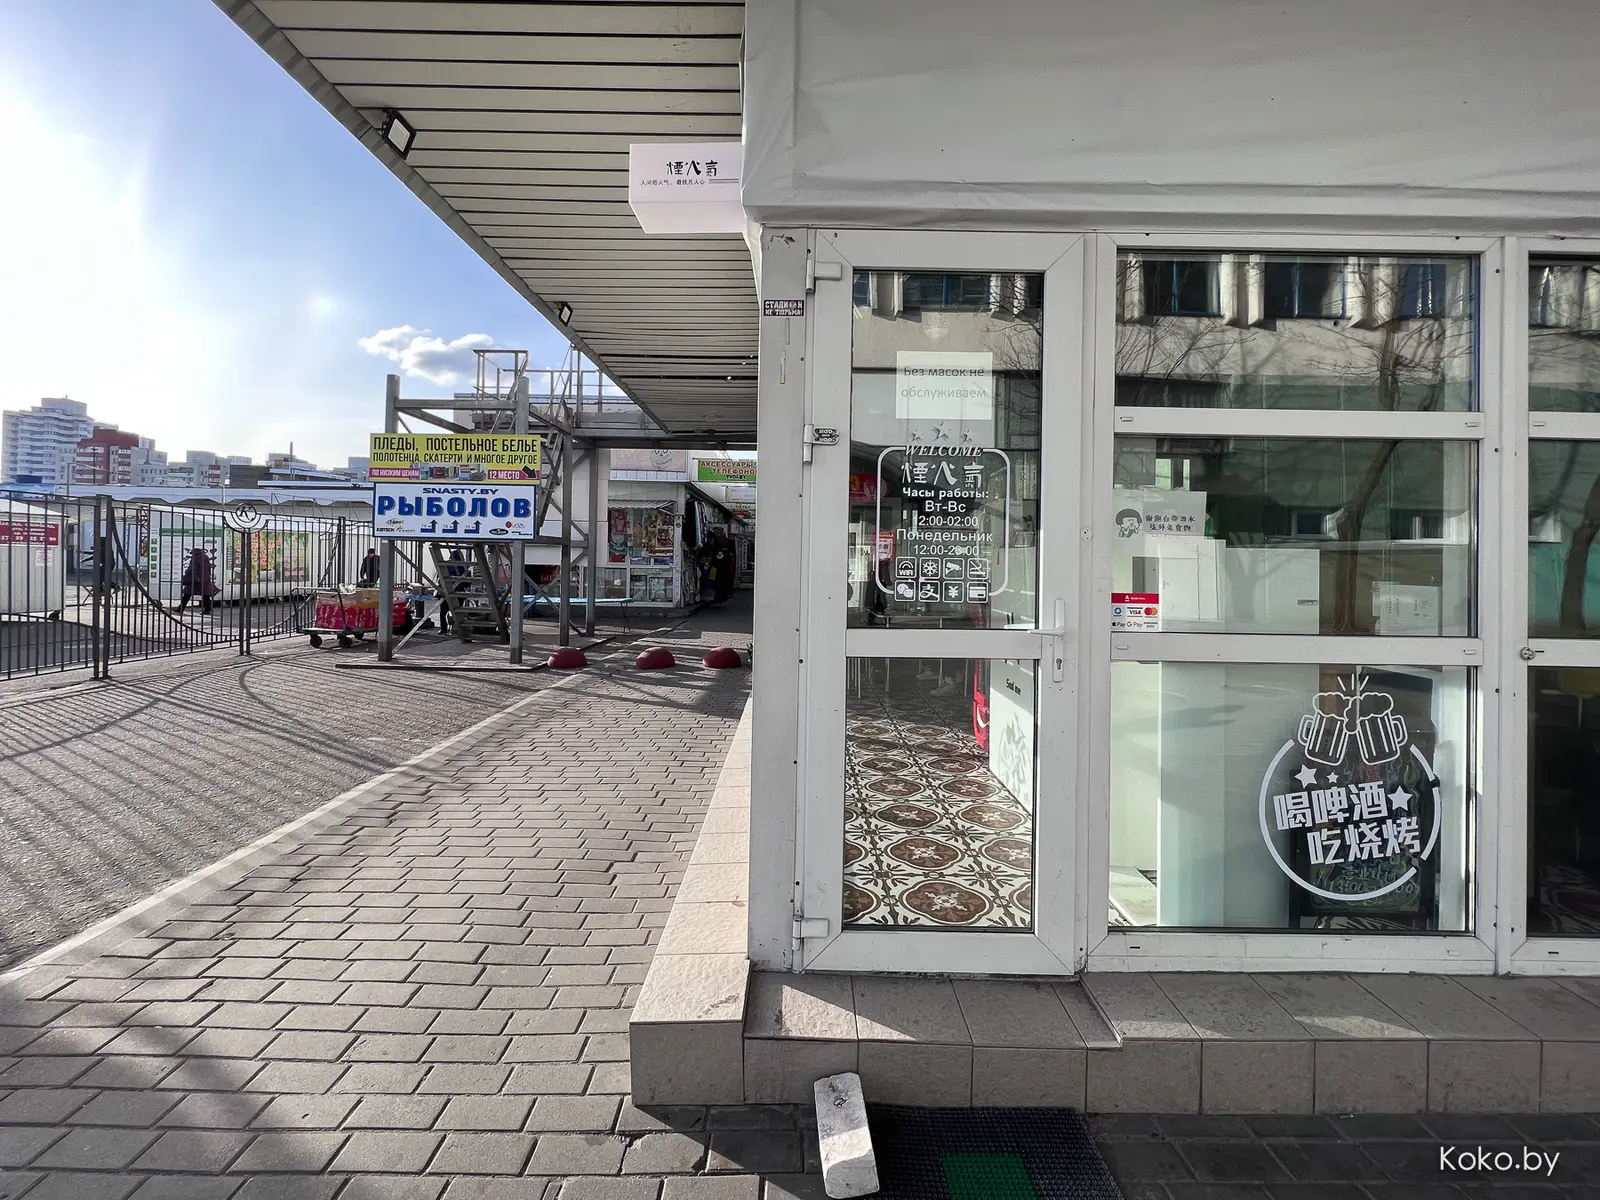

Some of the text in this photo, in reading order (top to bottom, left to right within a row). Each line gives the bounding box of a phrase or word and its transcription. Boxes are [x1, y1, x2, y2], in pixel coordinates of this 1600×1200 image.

[904, 366, 985, 377] Без масок не
[901, 386, 986, 400] обслуживаем
[373, 437, 538, 453] ПЛЕДЫ, ПОСТЕЛЬНОЕ БЕЛЬЕ
[905, 445, 983, 457] WELCOME
[373, 452, 537, 465] ПОЛОТЕНЦА, СКАТЕРТИ И МНОГОЕ ДРУГОЕ
[489, 471, 520, 480] 12 МЕСТО
[422, 487, 499, 495] SNASTY.BY
[902, 487, 989, 500] Часы работы:
[377, 495, 532, 518] РЫБОЛОВ
[925, 500, 966, 512] Вт-Вс
[896, 528, 993, 542] Понедельник
[1273, 781, 1388, 831] 喝啤酒
[1307, 816, 1420, 865] 吃烧烤
